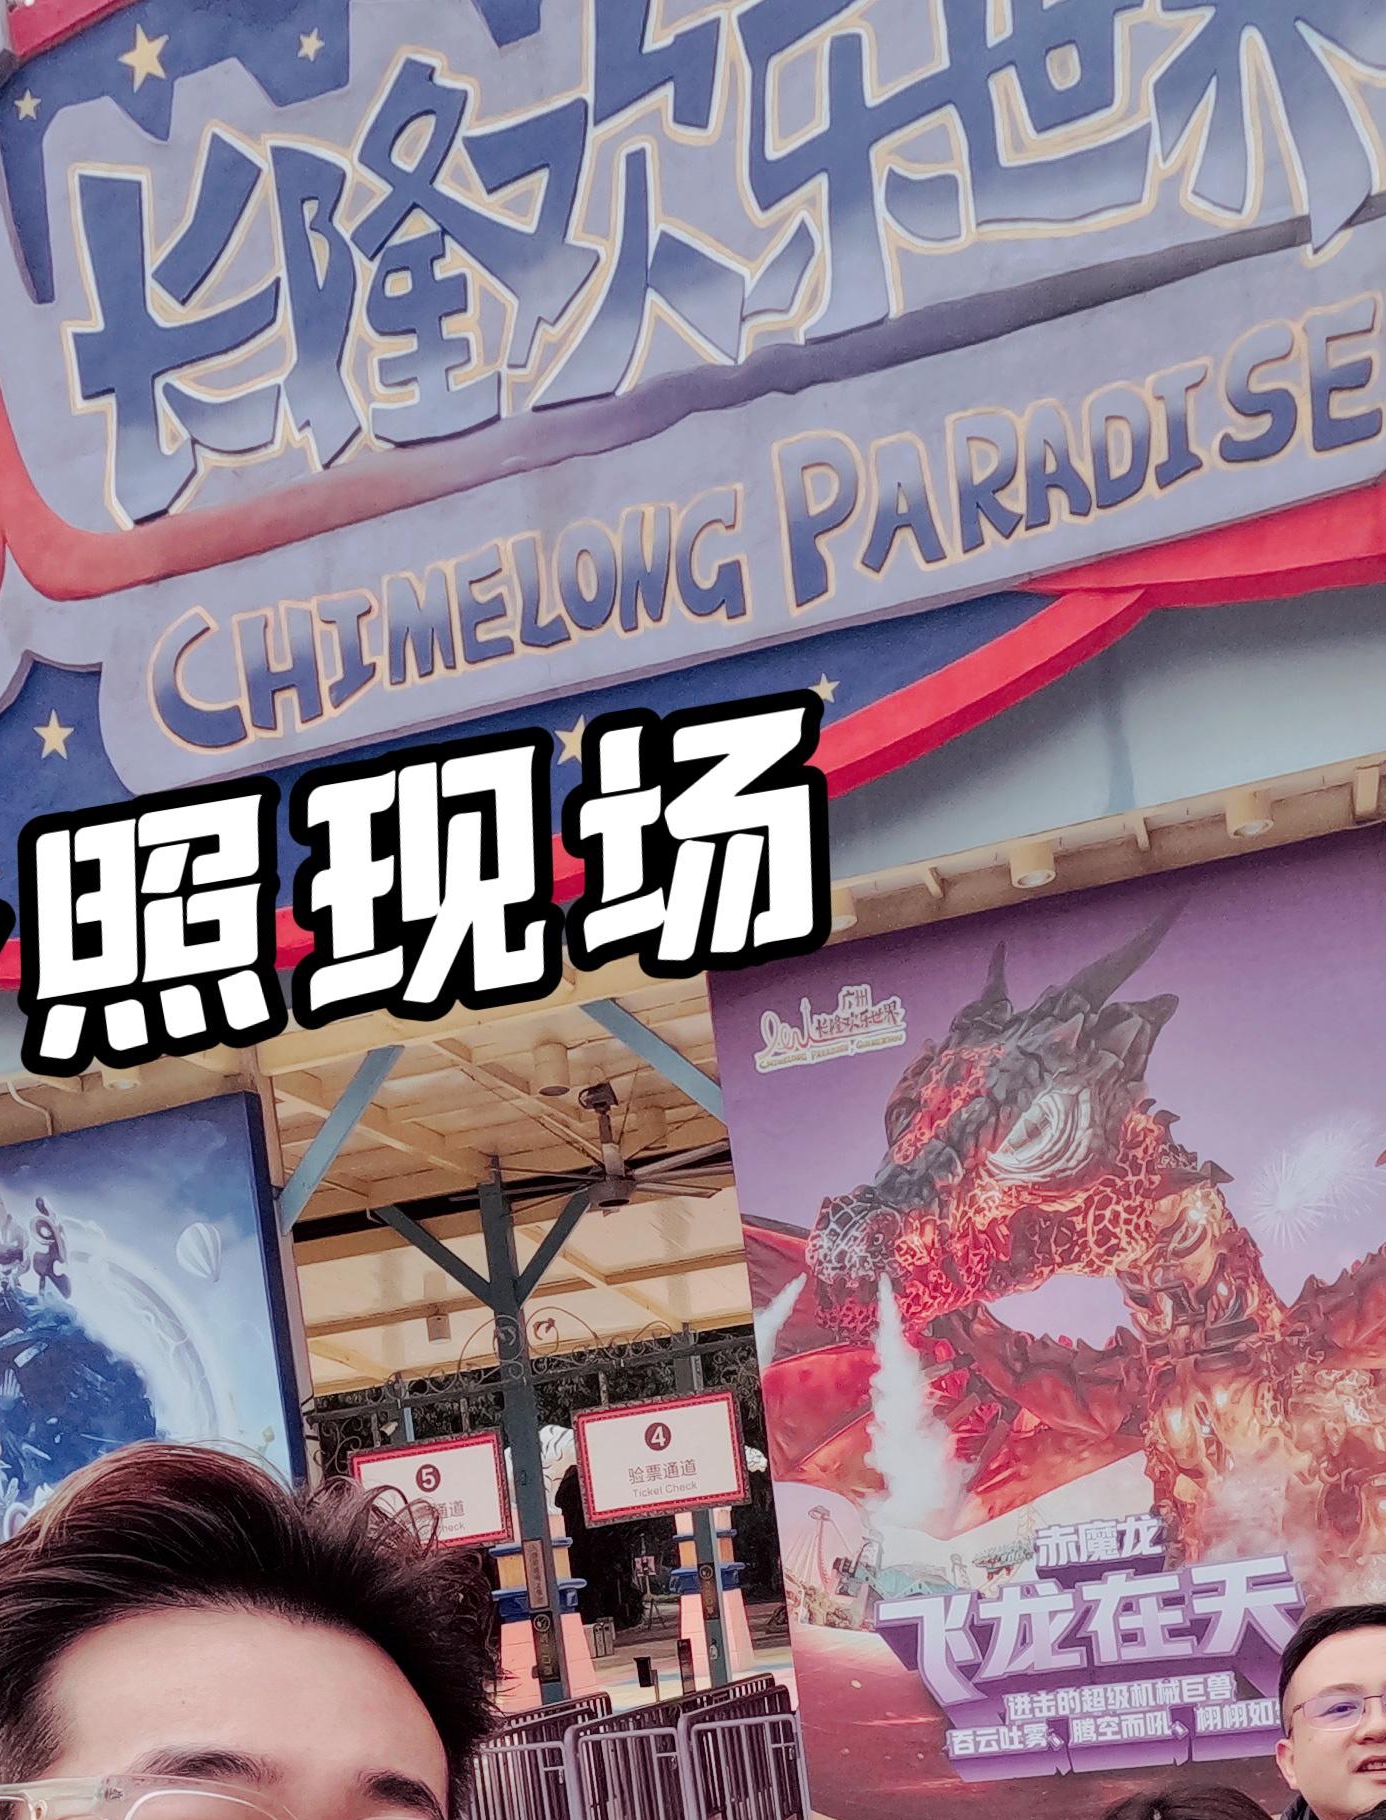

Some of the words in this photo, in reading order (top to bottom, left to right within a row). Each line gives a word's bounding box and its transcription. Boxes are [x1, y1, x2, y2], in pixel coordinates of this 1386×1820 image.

[151, 485, 750, 746] CHIMELONG
[775, 292, 1384, 610] PARADISE
[649, 1424, 668, 1449] 4
[419, 1466, 438, 1490] 5
[627, 1460, 697, 1486] 验票通道
[632, 1484, 663, 1498] Ticket
[664, 1480, 698, 1495] Check
[1037, 1515, 1165, 1567] 赤魔龙
[878, 1555, 1300, 1703] 飞龙在天
[1007, 1673, 1235, 1721] 进击的超级机械巨兽
